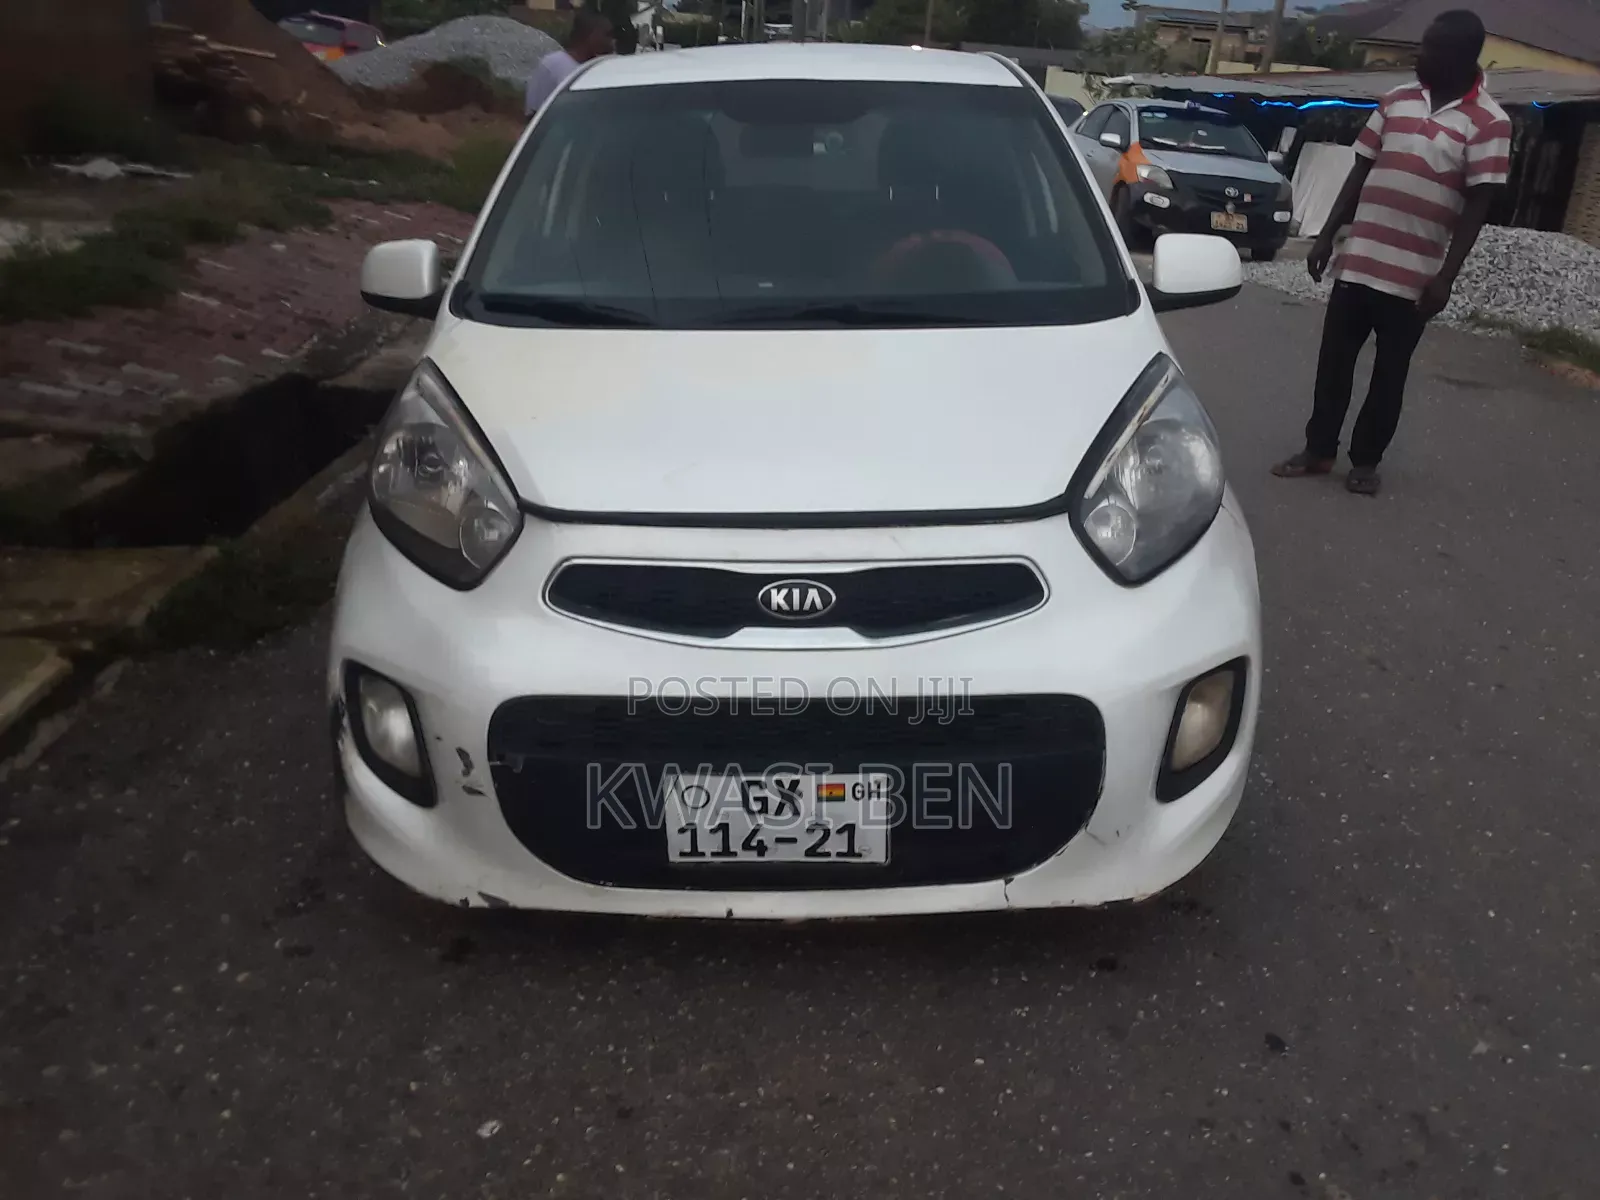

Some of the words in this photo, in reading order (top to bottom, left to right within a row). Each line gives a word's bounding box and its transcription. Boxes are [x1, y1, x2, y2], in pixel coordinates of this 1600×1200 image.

[770, 588, 824, 611] KIA
[741, 779, 801, 815] GX
[851, 782, 881, 800] GH
[677, 822, 862, 857] 114-21
